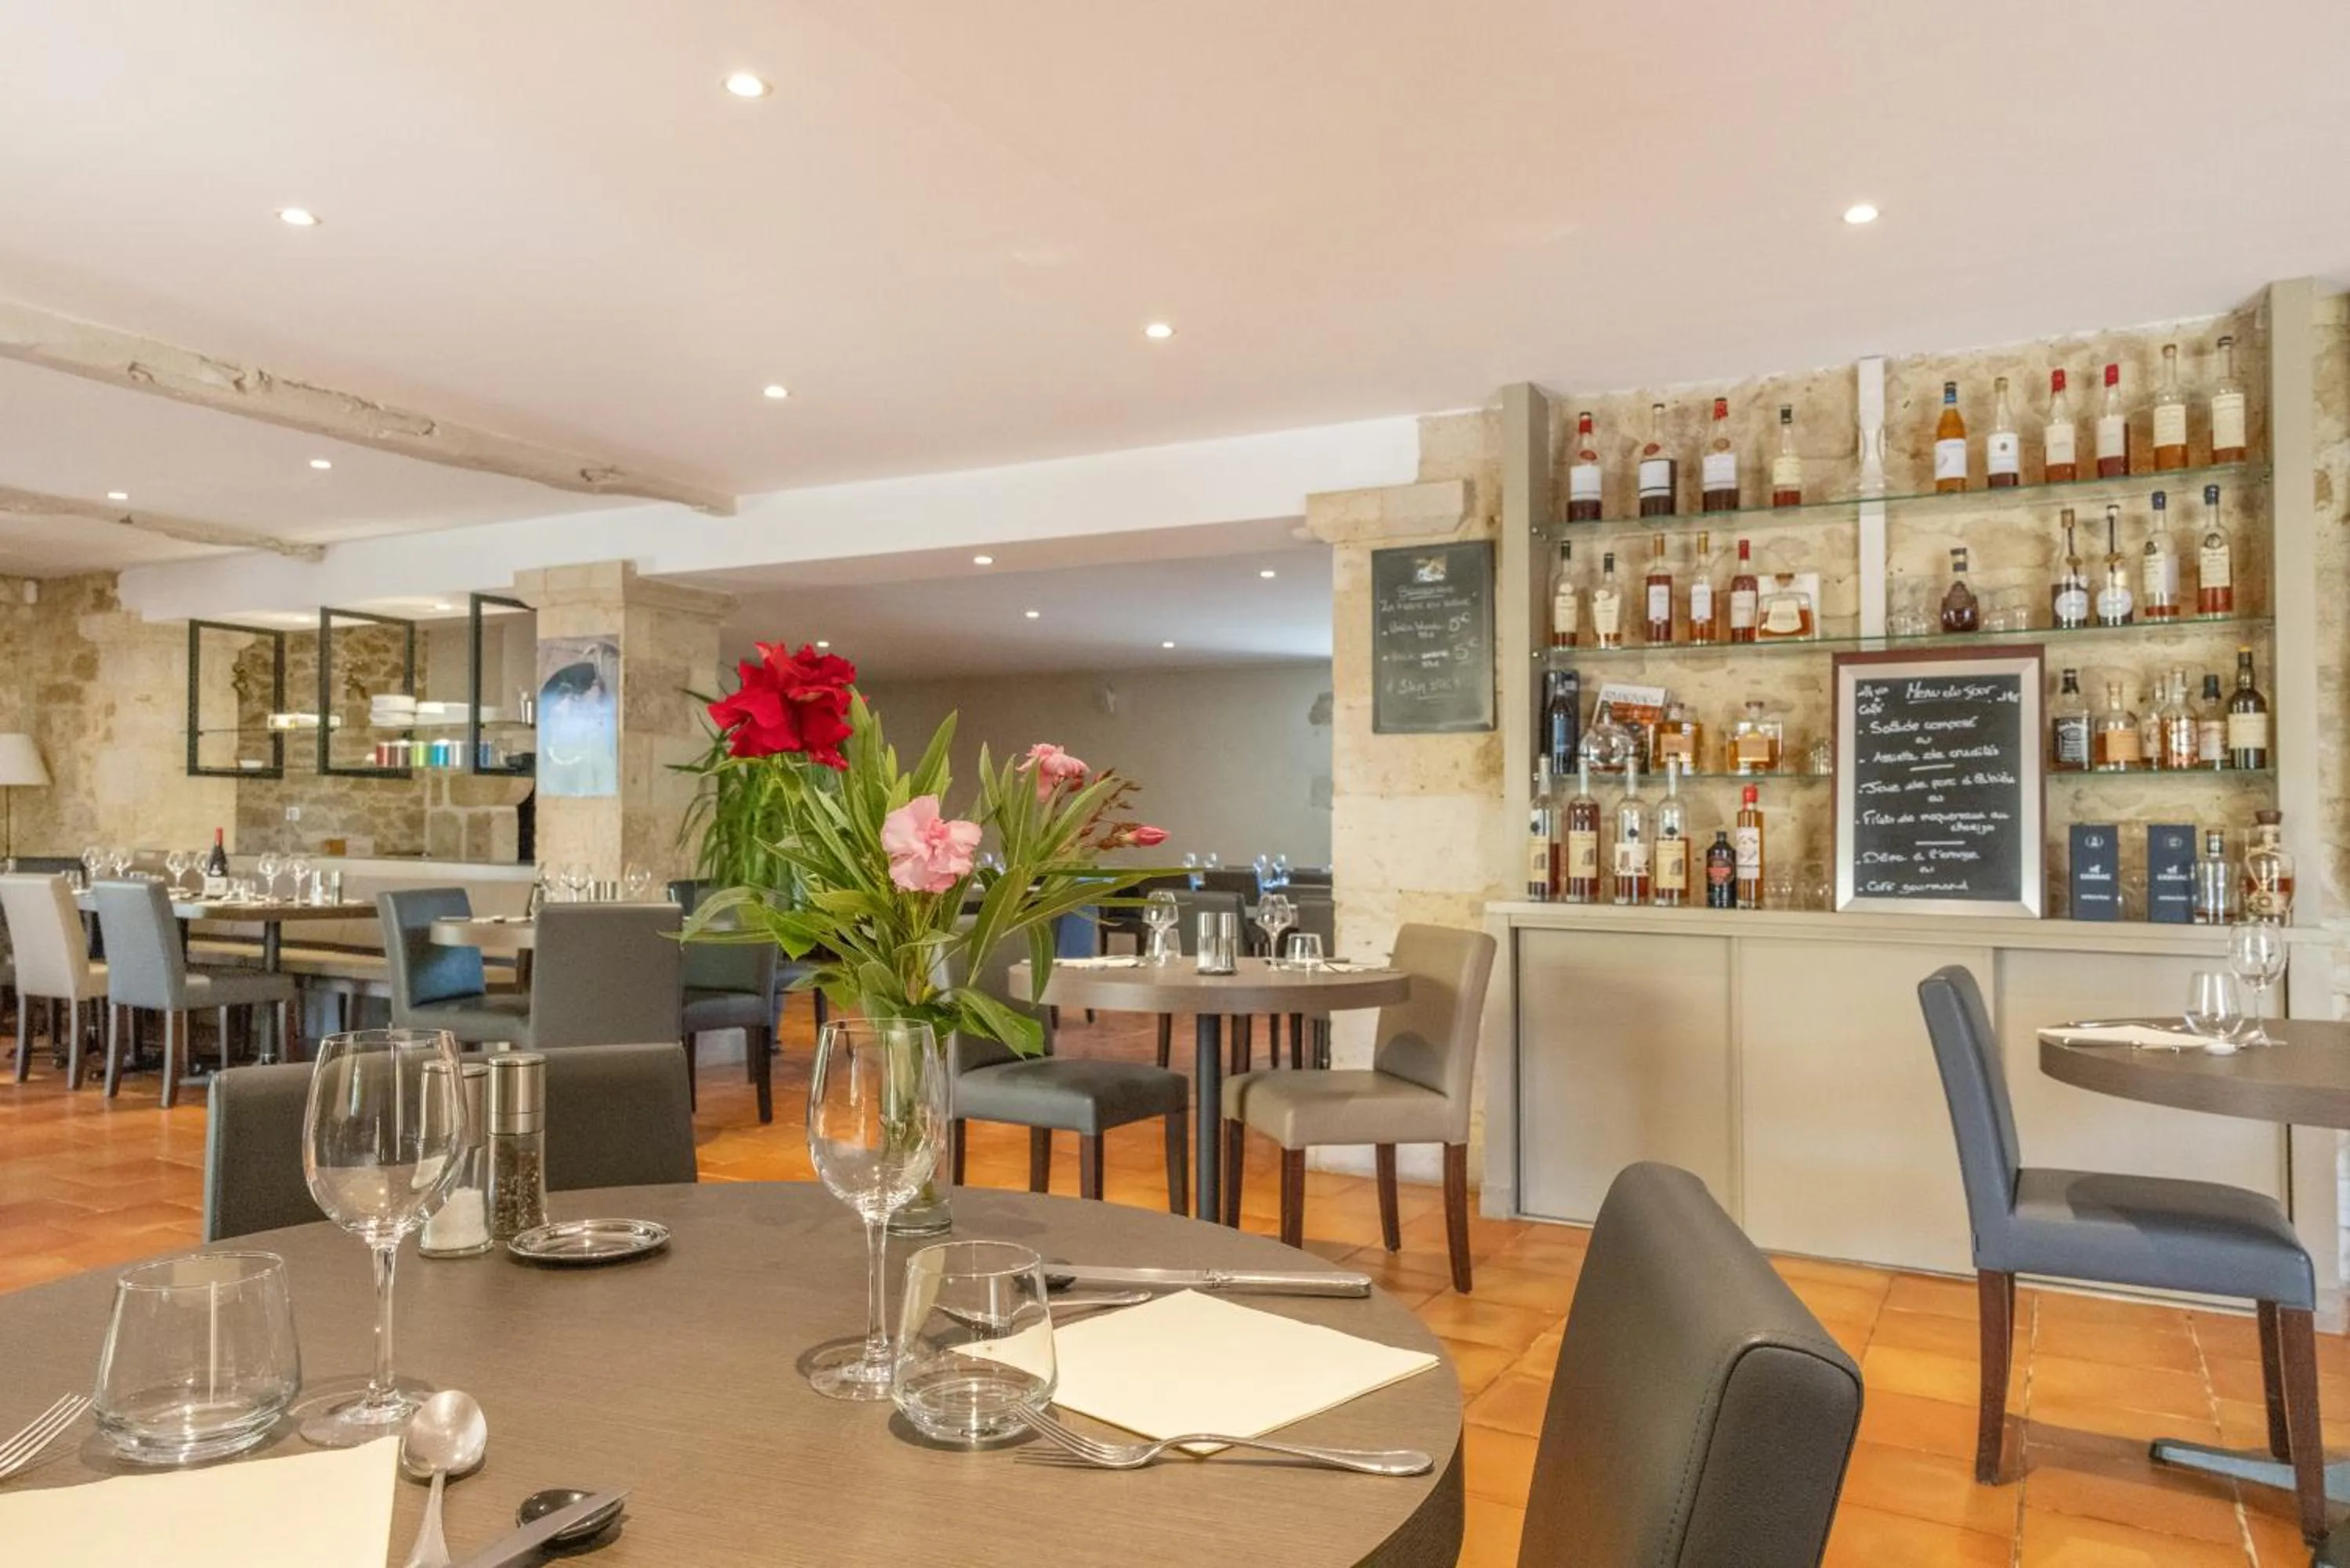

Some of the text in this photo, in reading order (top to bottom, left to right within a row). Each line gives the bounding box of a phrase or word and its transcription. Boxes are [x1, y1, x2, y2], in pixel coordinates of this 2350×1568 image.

[1905, 681, 1941, 699] Menu
[1870, 720, 1920, 734] Salade
[1922, 747, 1945, 760] de
[1904, 780, 1929, 791] de
[1897, 812, 1915, 823] de
[1867, 879, 1969, 894] Café gourmand
